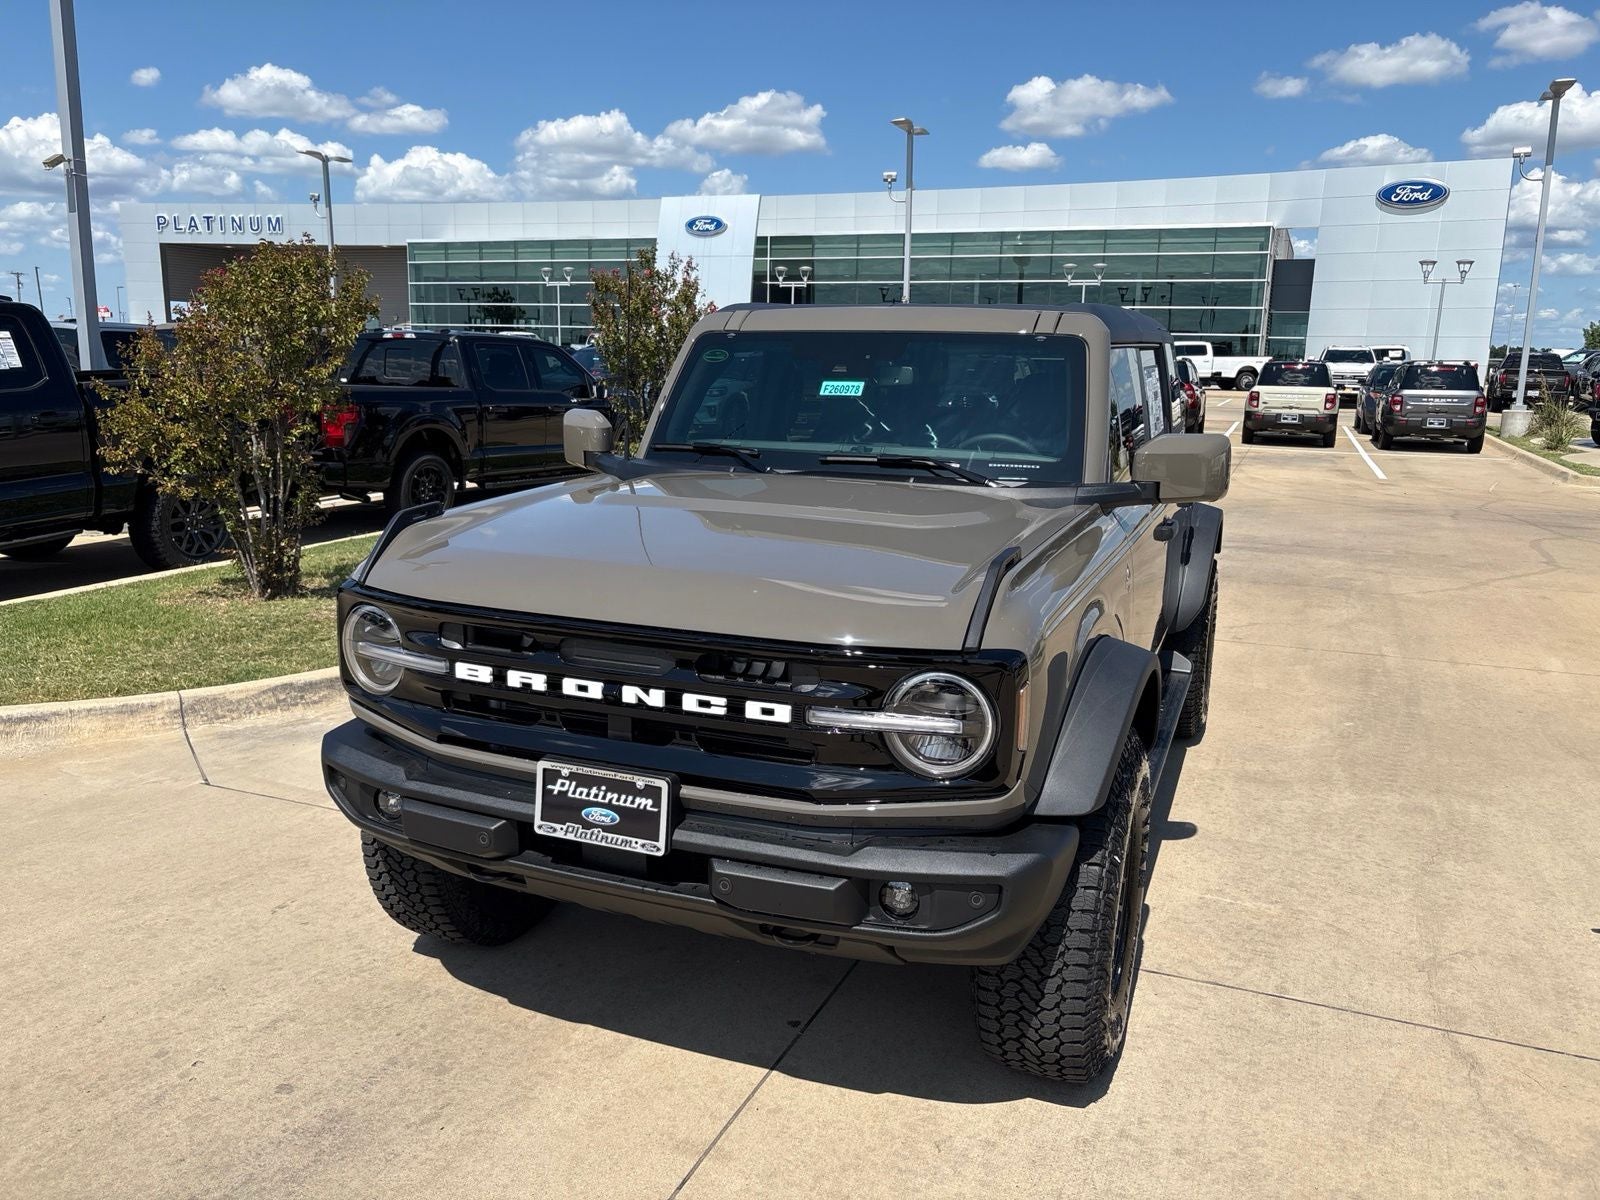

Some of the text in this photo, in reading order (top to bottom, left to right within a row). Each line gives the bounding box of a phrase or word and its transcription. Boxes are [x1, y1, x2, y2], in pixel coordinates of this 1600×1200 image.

[1391, 185, 1433, 202] Ford
[156, 214, 284, 234] PLATINUM
[822, 384, 861, 395] F260978
[454, 661, 792, 724] BRONCO
[550, 763, 656, 785] www.PlatinumFord.com
[546, 779, 660, 812] Platinum
[563, 824, 638, 850] Platinum
